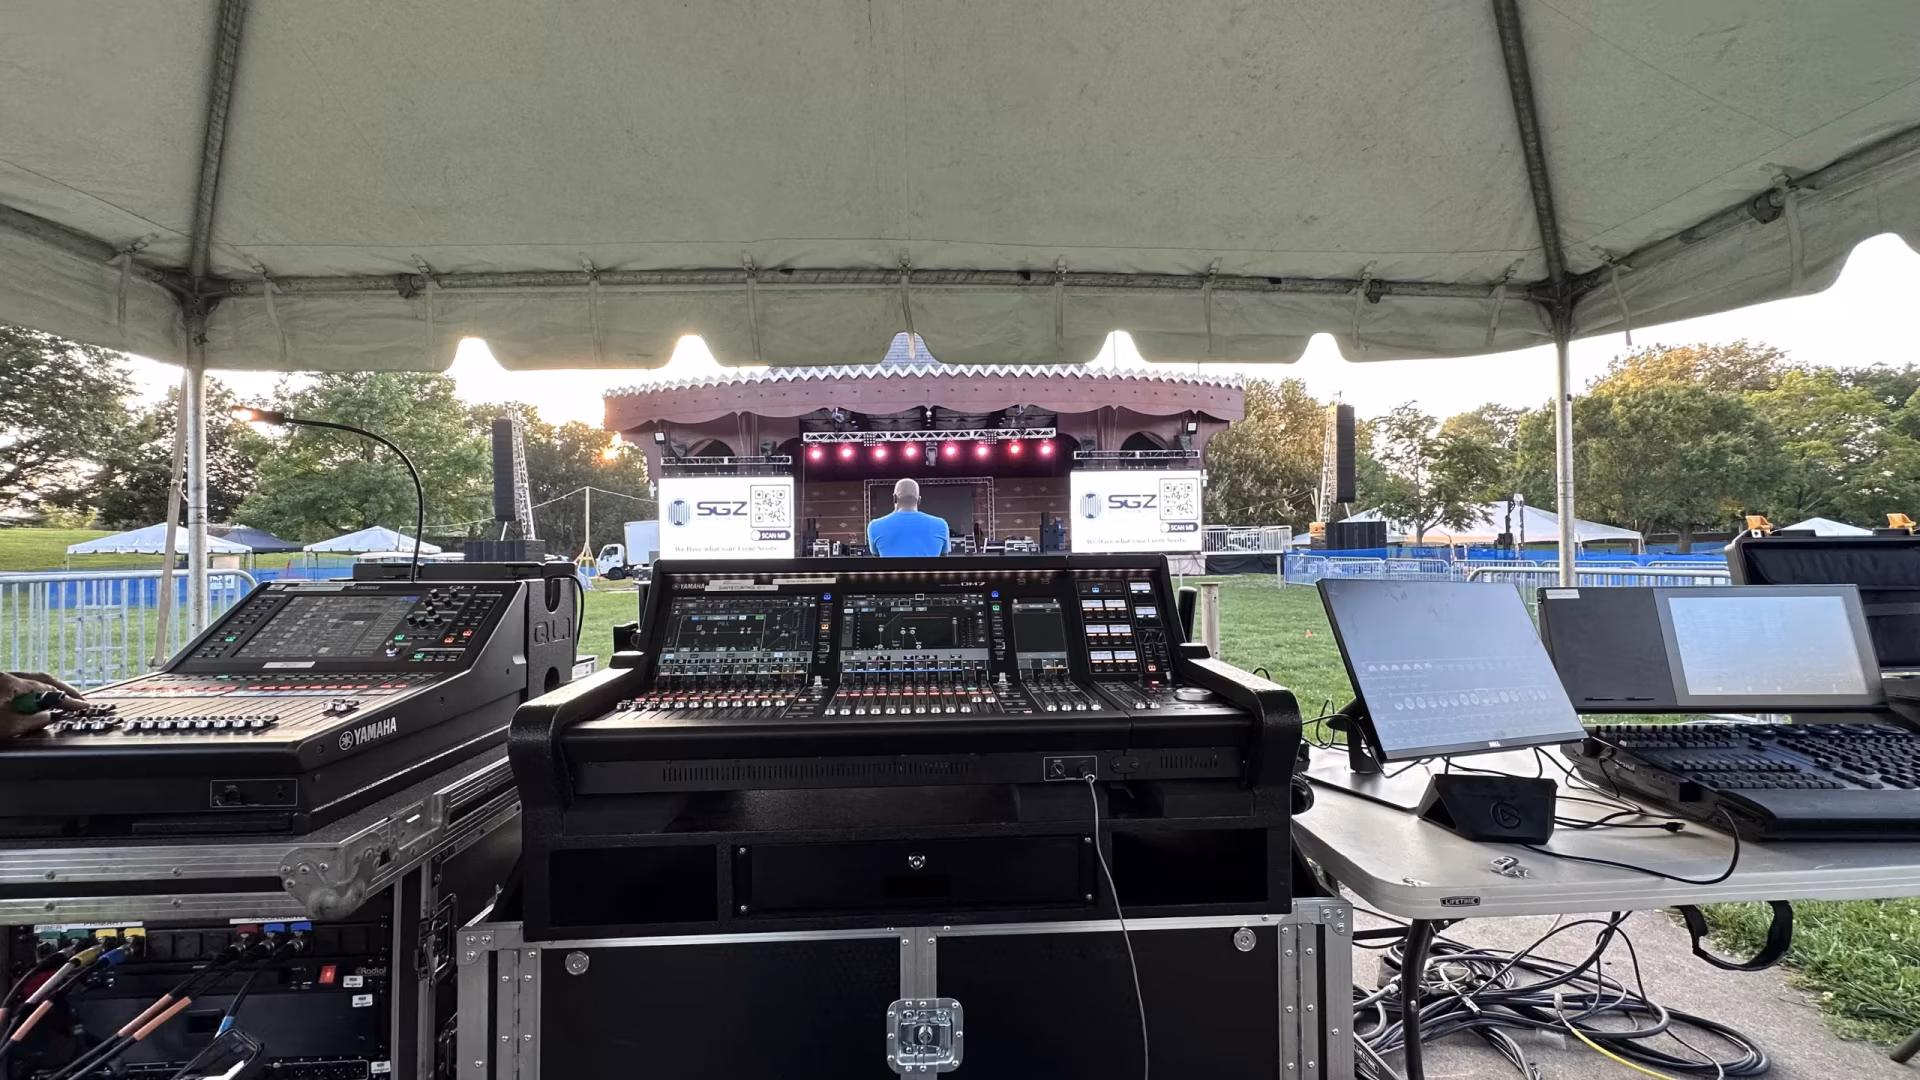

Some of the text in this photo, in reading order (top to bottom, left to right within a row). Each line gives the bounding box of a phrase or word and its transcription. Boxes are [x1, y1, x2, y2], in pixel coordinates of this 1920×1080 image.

[697, 501, 748, 516] SGZ
[1108, 494, 1157, 508] SGZ
[533, 617, 571, 646] QL1
[353, 716, 397, 746] YAMAHA
